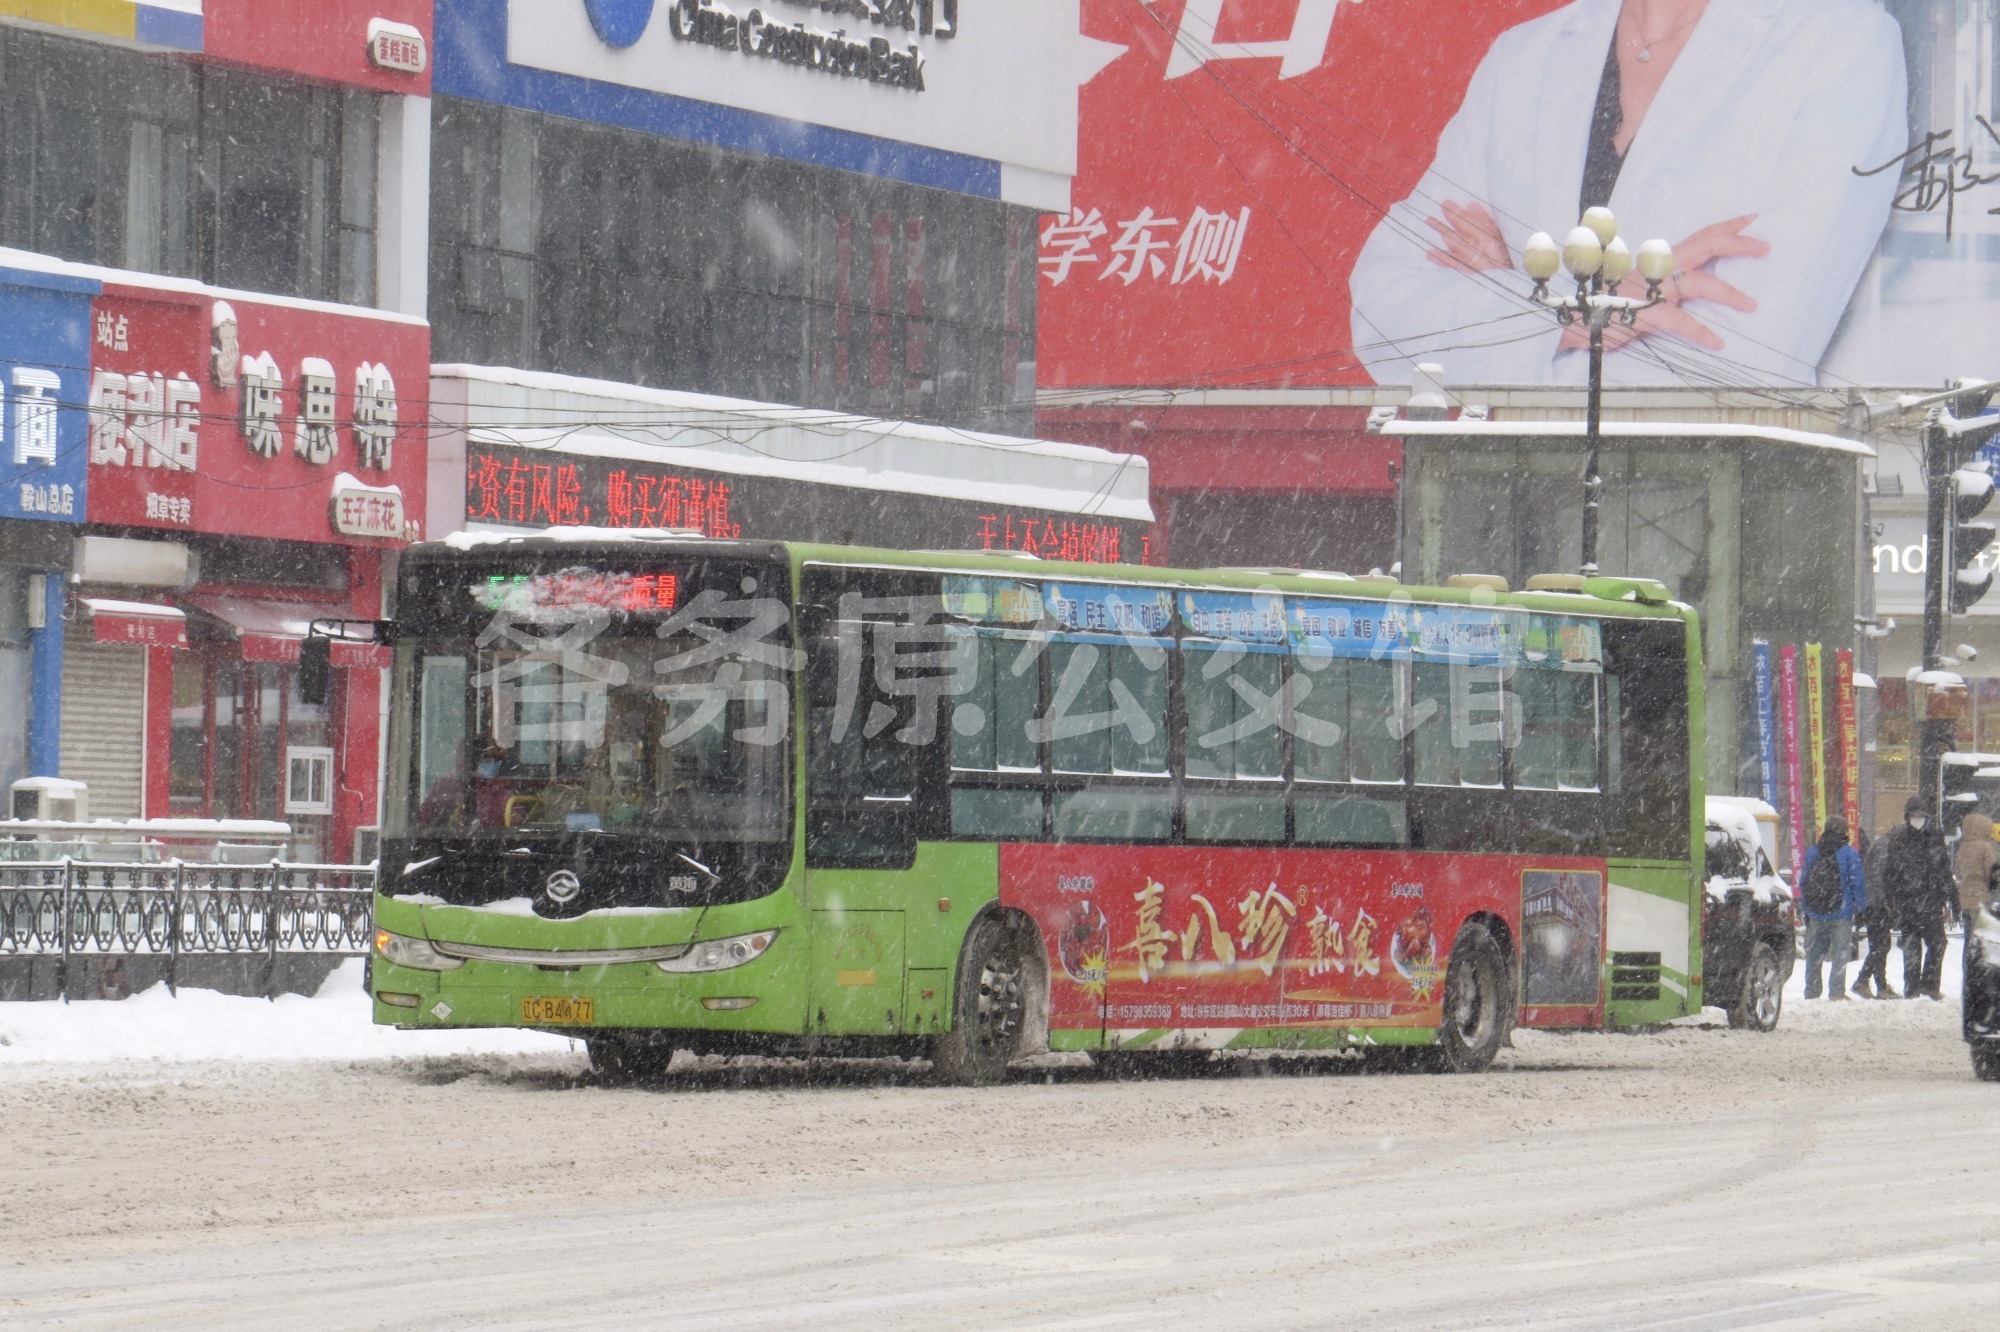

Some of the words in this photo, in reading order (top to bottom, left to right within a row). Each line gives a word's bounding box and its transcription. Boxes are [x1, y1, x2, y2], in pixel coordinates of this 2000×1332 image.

[868, 36, 926, 92] Bank
[1038, 206, 1251, 287] 学东侧
[97, 311, 129, 352] 站点
[0, 366, 61, 466] 面
[89, 366, 200, 472] 便利店
[240, 358, 398, 471] 味思特
[20, 483, 75, 516] 鞍山总店
[342, 497, 396, 532] 王子麻花
[1086, 600, 1107, 630] 民主
[1302, 615, 1321, 637] 爱国
[1353, 618, 1373, 639] 诚信
[1378, 619, 1398, 640] 友善
[1116, 876, 1297, 984] 喜八珍
